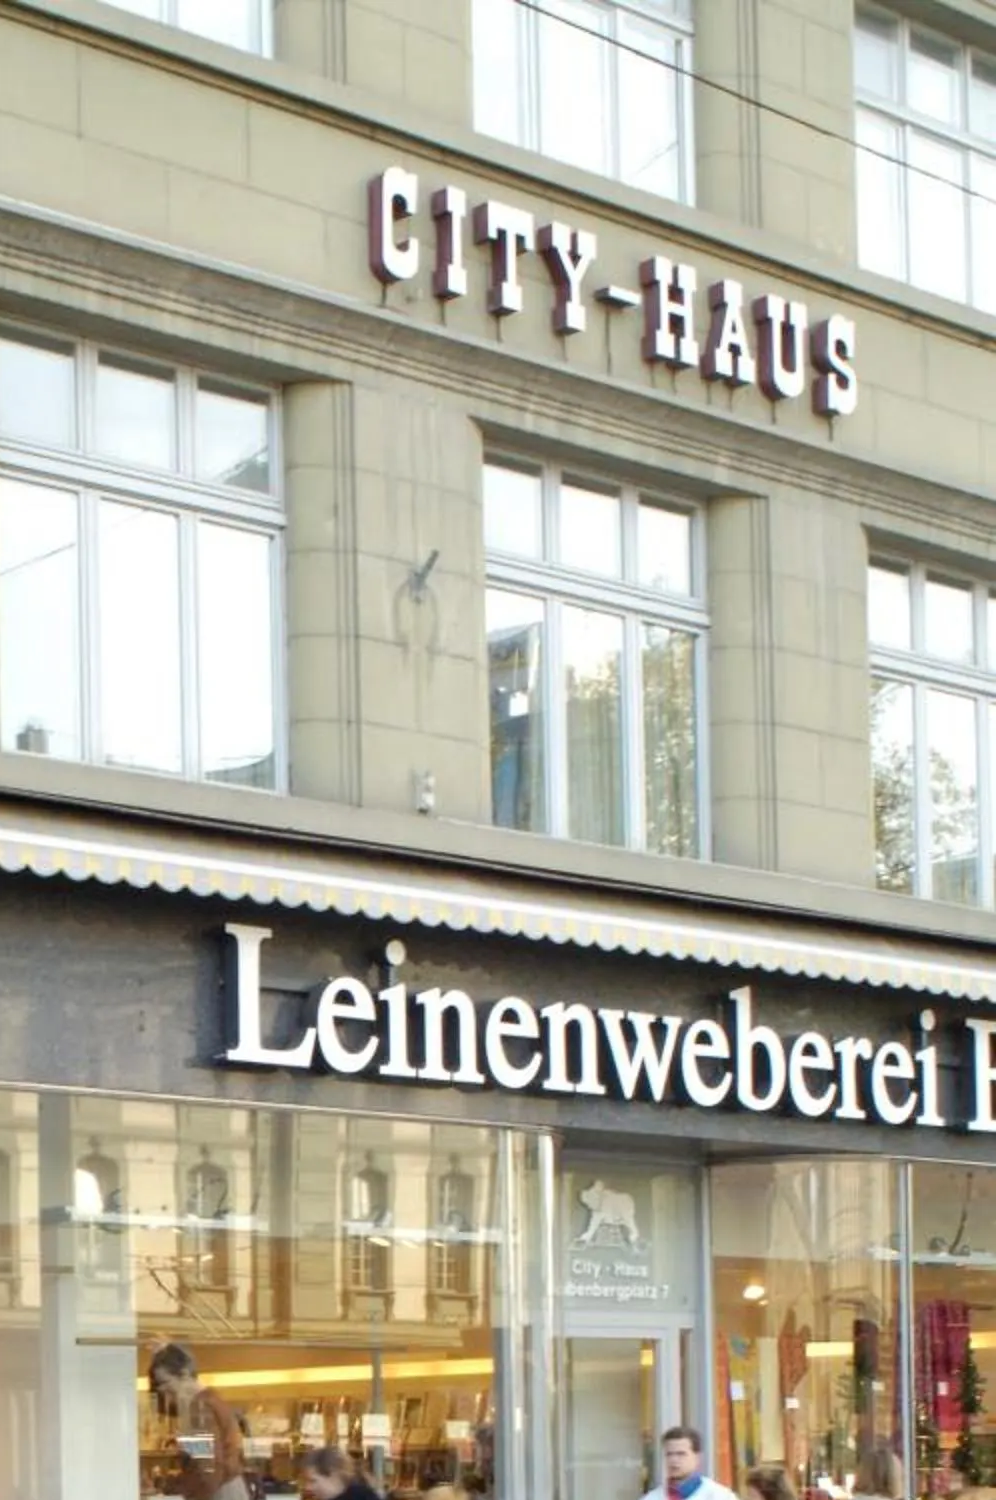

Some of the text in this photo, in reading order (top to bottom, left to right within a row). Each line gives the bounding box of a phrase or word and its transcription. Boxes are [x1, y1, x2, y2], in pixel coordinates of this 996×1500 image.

[370, 167, 859, 417] CITY-HAUS
[225, 923, 946, 1127] Leinenweberei
[572, 1259, 602, 1279] City
